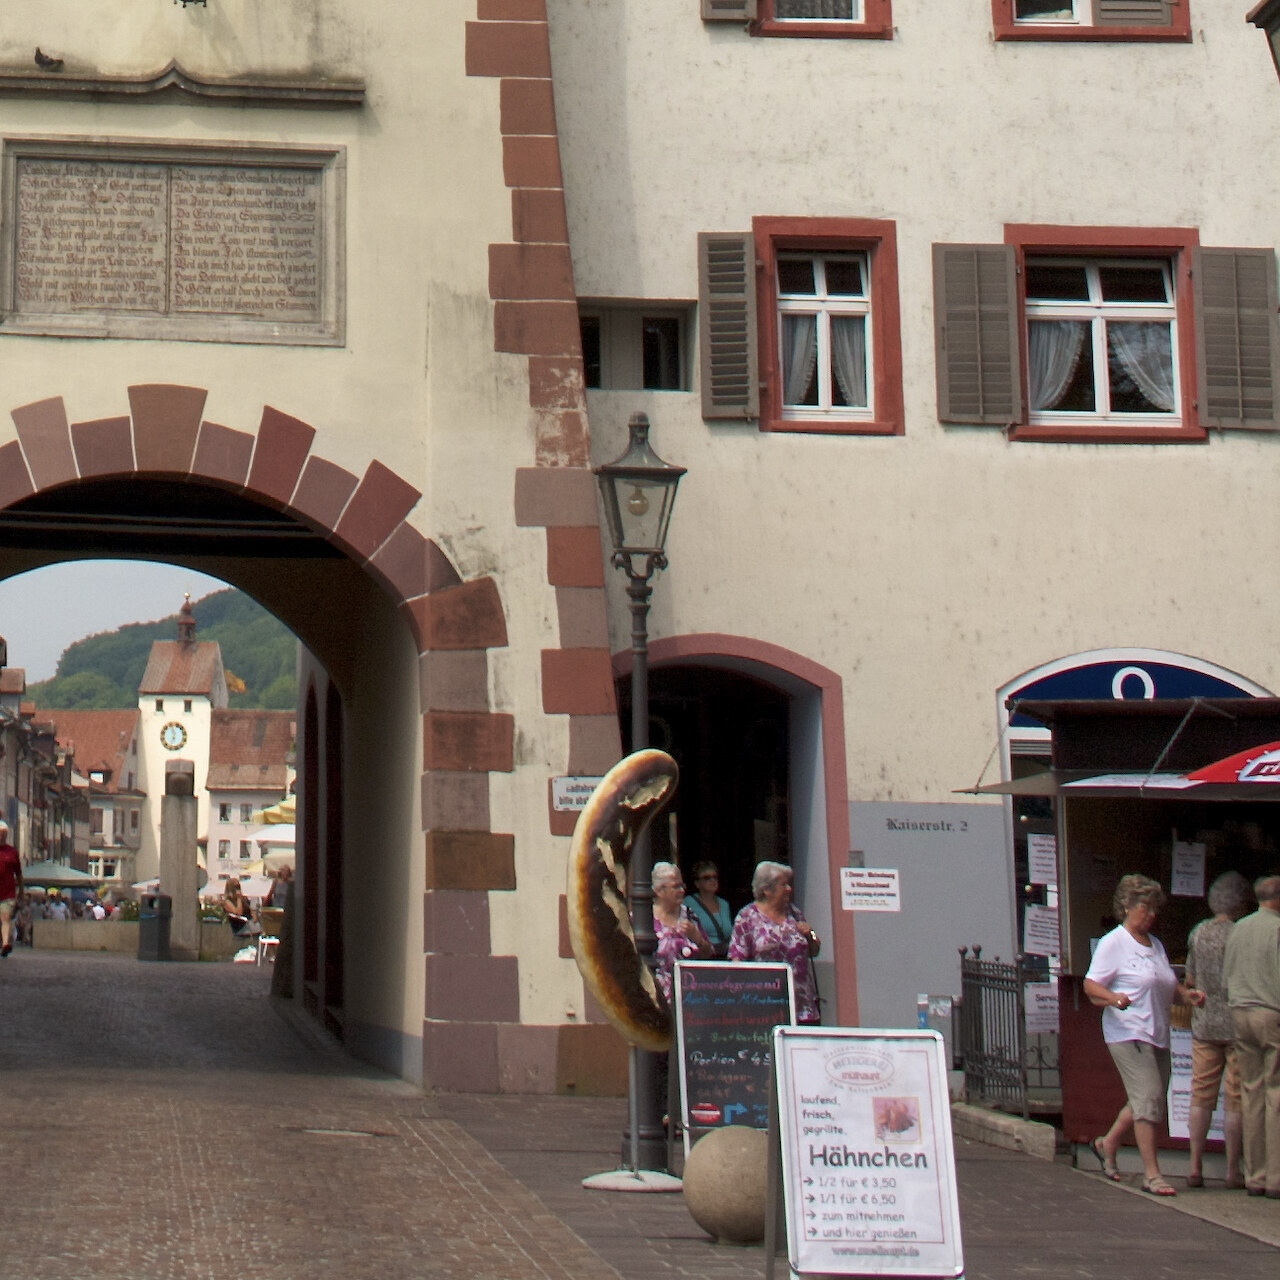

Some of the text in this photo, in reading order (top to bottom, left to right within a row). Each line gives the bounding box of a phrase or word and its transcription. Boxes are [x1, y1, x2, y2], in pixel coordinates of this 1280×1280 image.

[886, 818, 968, 832] Kaiserstr. 2
[809, 1144, 928, 1168] Hähnchen
[819, 1177, 896, 1189] 1/2 für € 3,50
[820, 1193, 896, 1206] 1/1 für € 6,50
[822, 1211, 905, 1222] zum mitnehmen
[823, 1227, 917, 1241] und hier genießen
